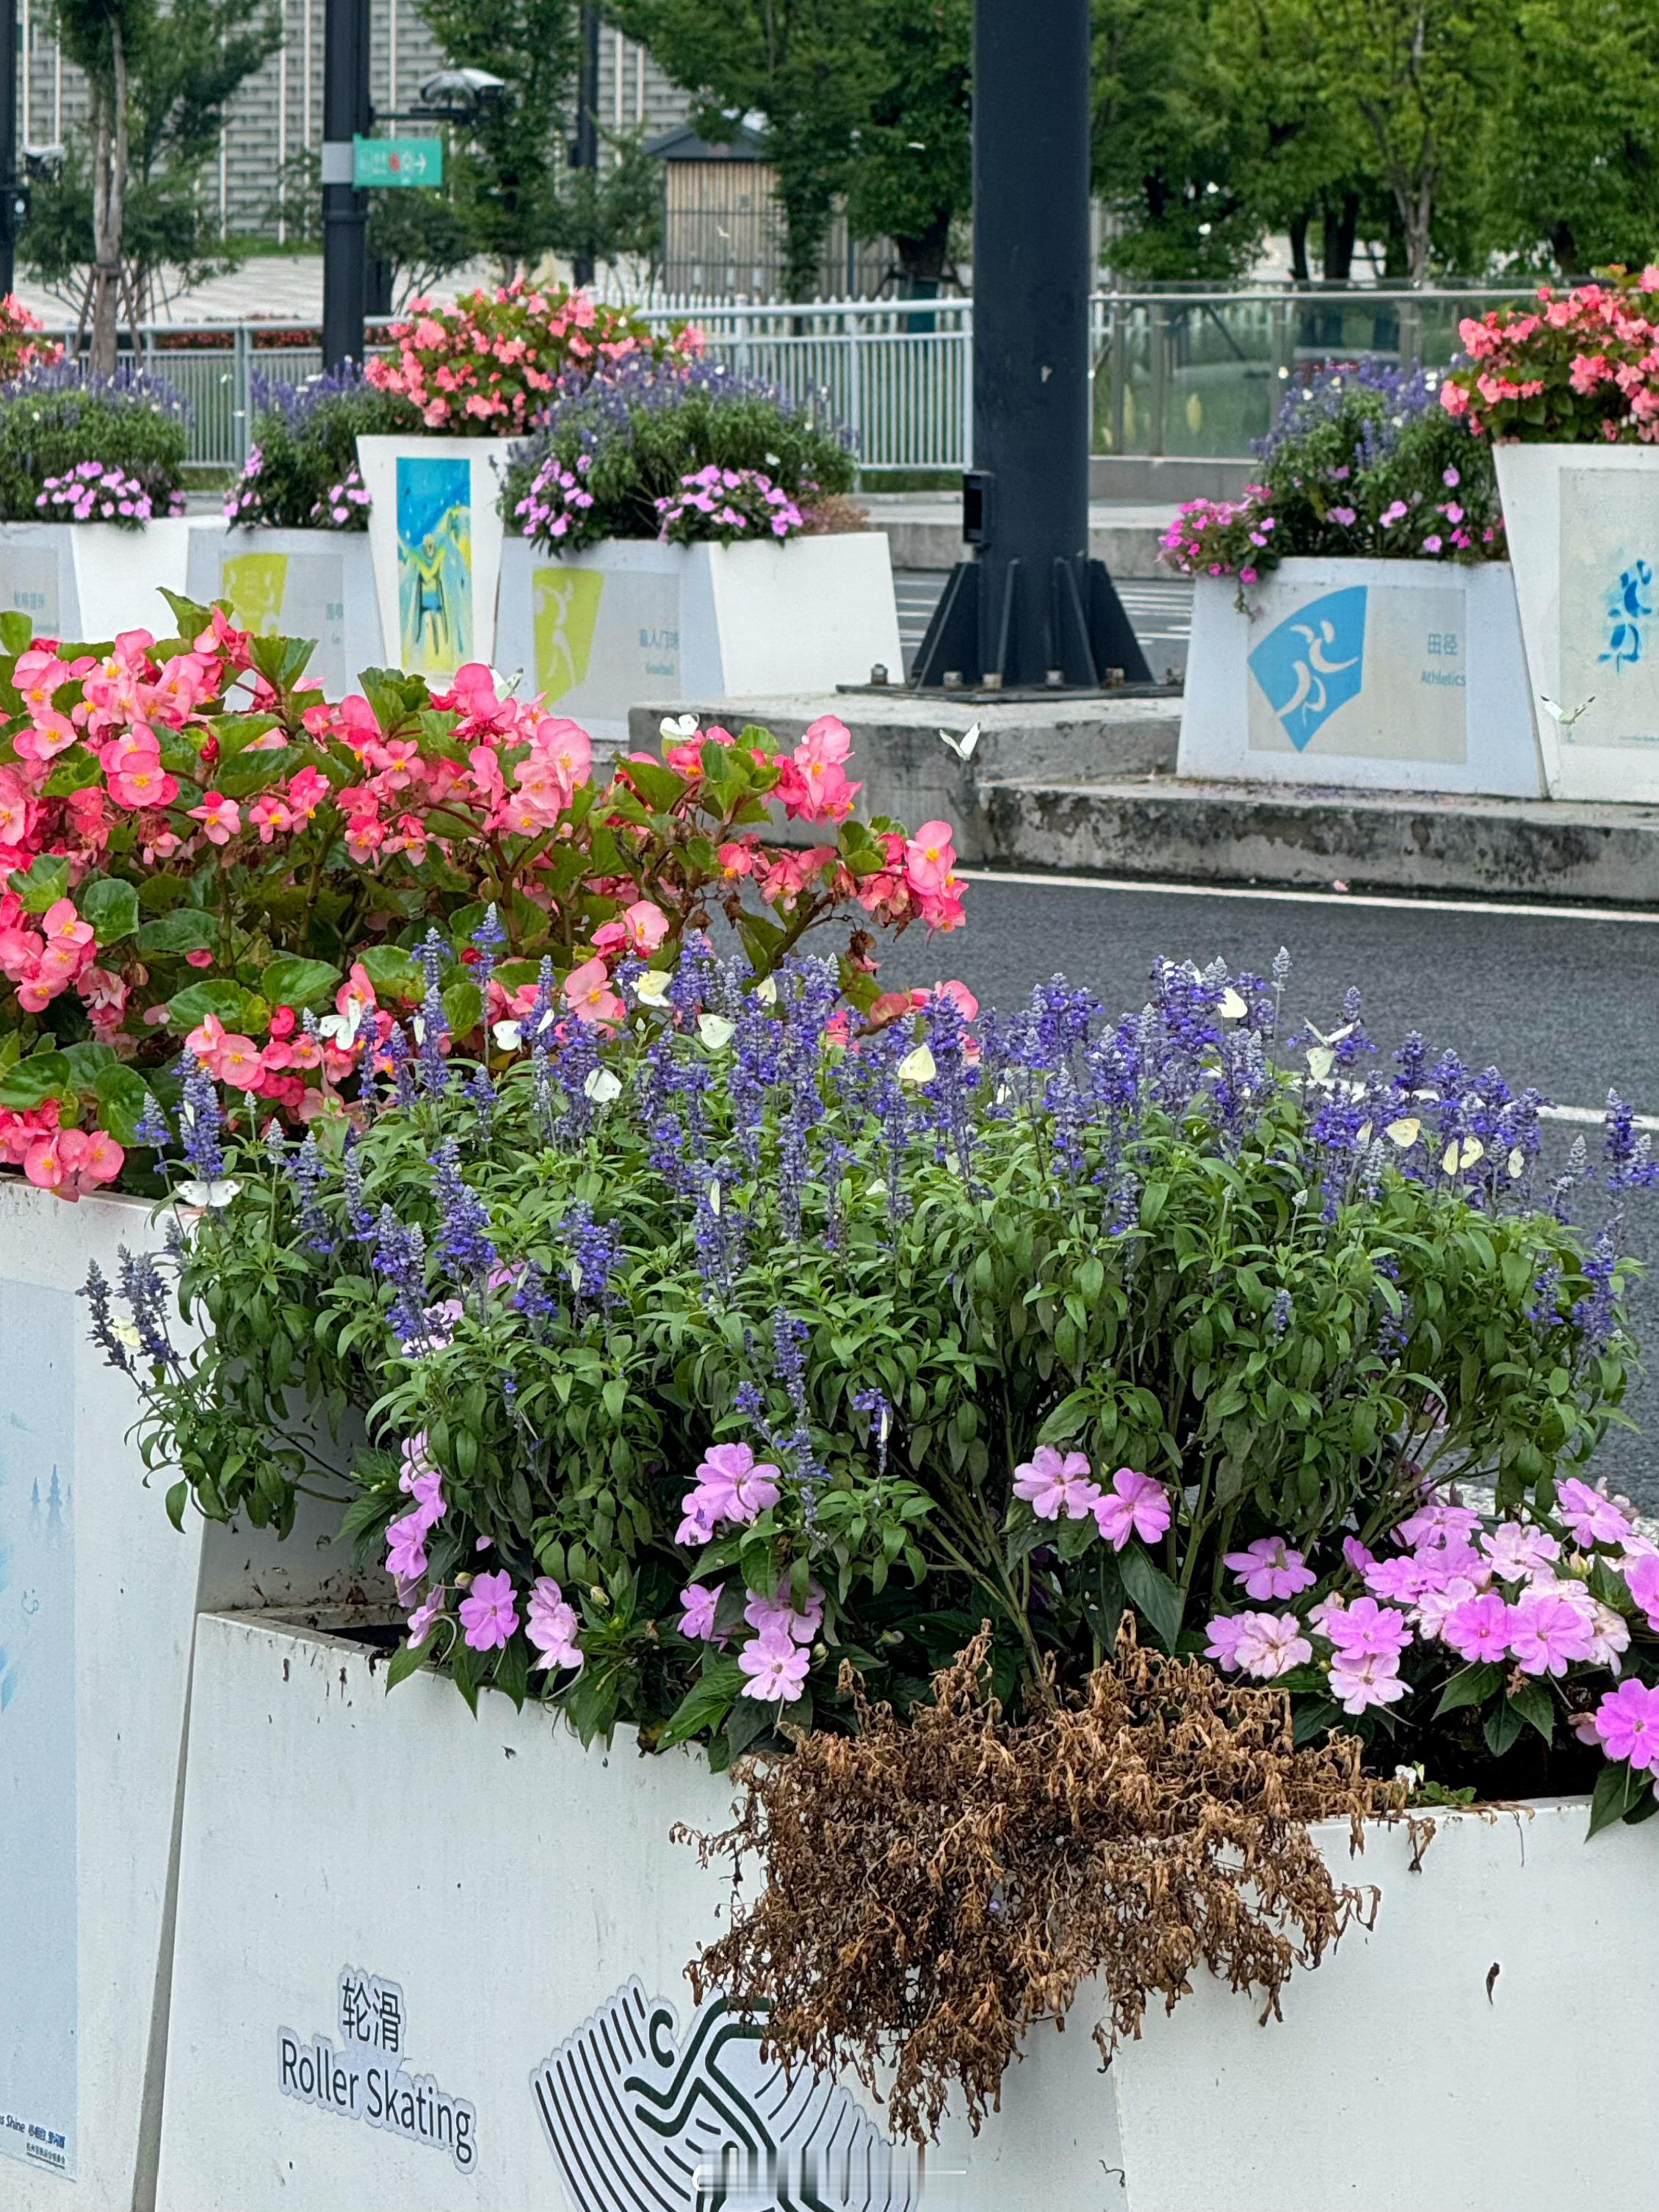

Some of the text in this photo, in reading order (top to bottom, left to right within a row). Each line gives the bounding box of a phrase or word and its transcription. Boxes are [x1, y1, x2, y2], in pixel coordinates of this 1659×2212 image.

[1428, 633, 1458, 655] 田径
[1422, 669, 1466, 687] Athletics
[342, 1977, 401, 2053] 轮滑
[281, 2038, 472, 2164] Roller Skating
[6, 2114, 26, 2133] Shine
